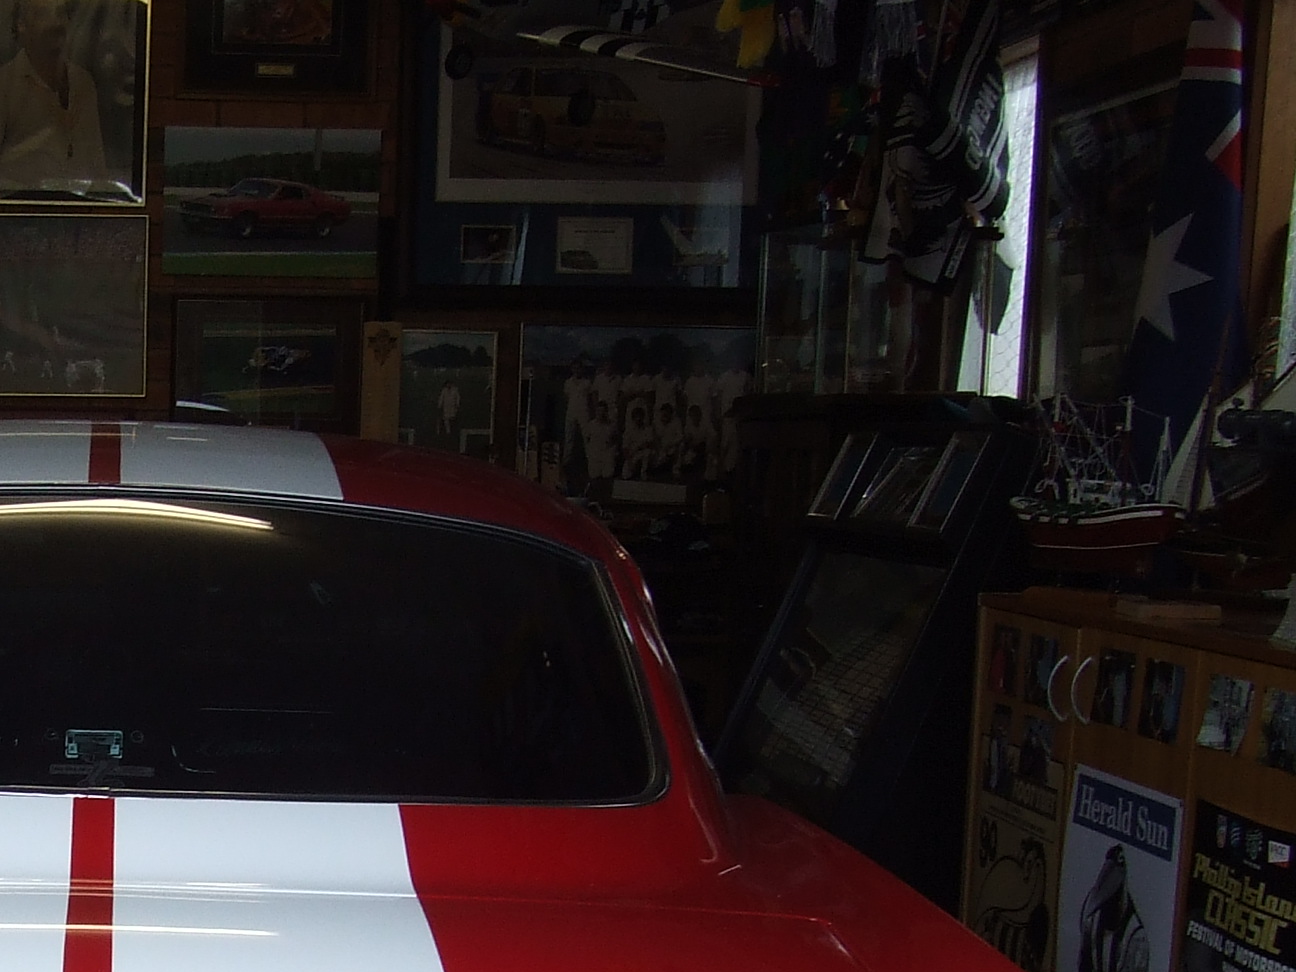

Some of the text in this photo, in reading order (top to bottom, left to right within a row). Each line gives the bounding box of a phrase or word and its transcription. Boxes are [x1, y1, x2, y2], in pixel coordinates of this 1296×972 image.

[1077, 783, 1134, 837] Herald
[1135, 804, 1169, 851] Sun
[1186, 919, 1224, 953] FESTIVAL
[1223, 938, 1236, 959] OF
